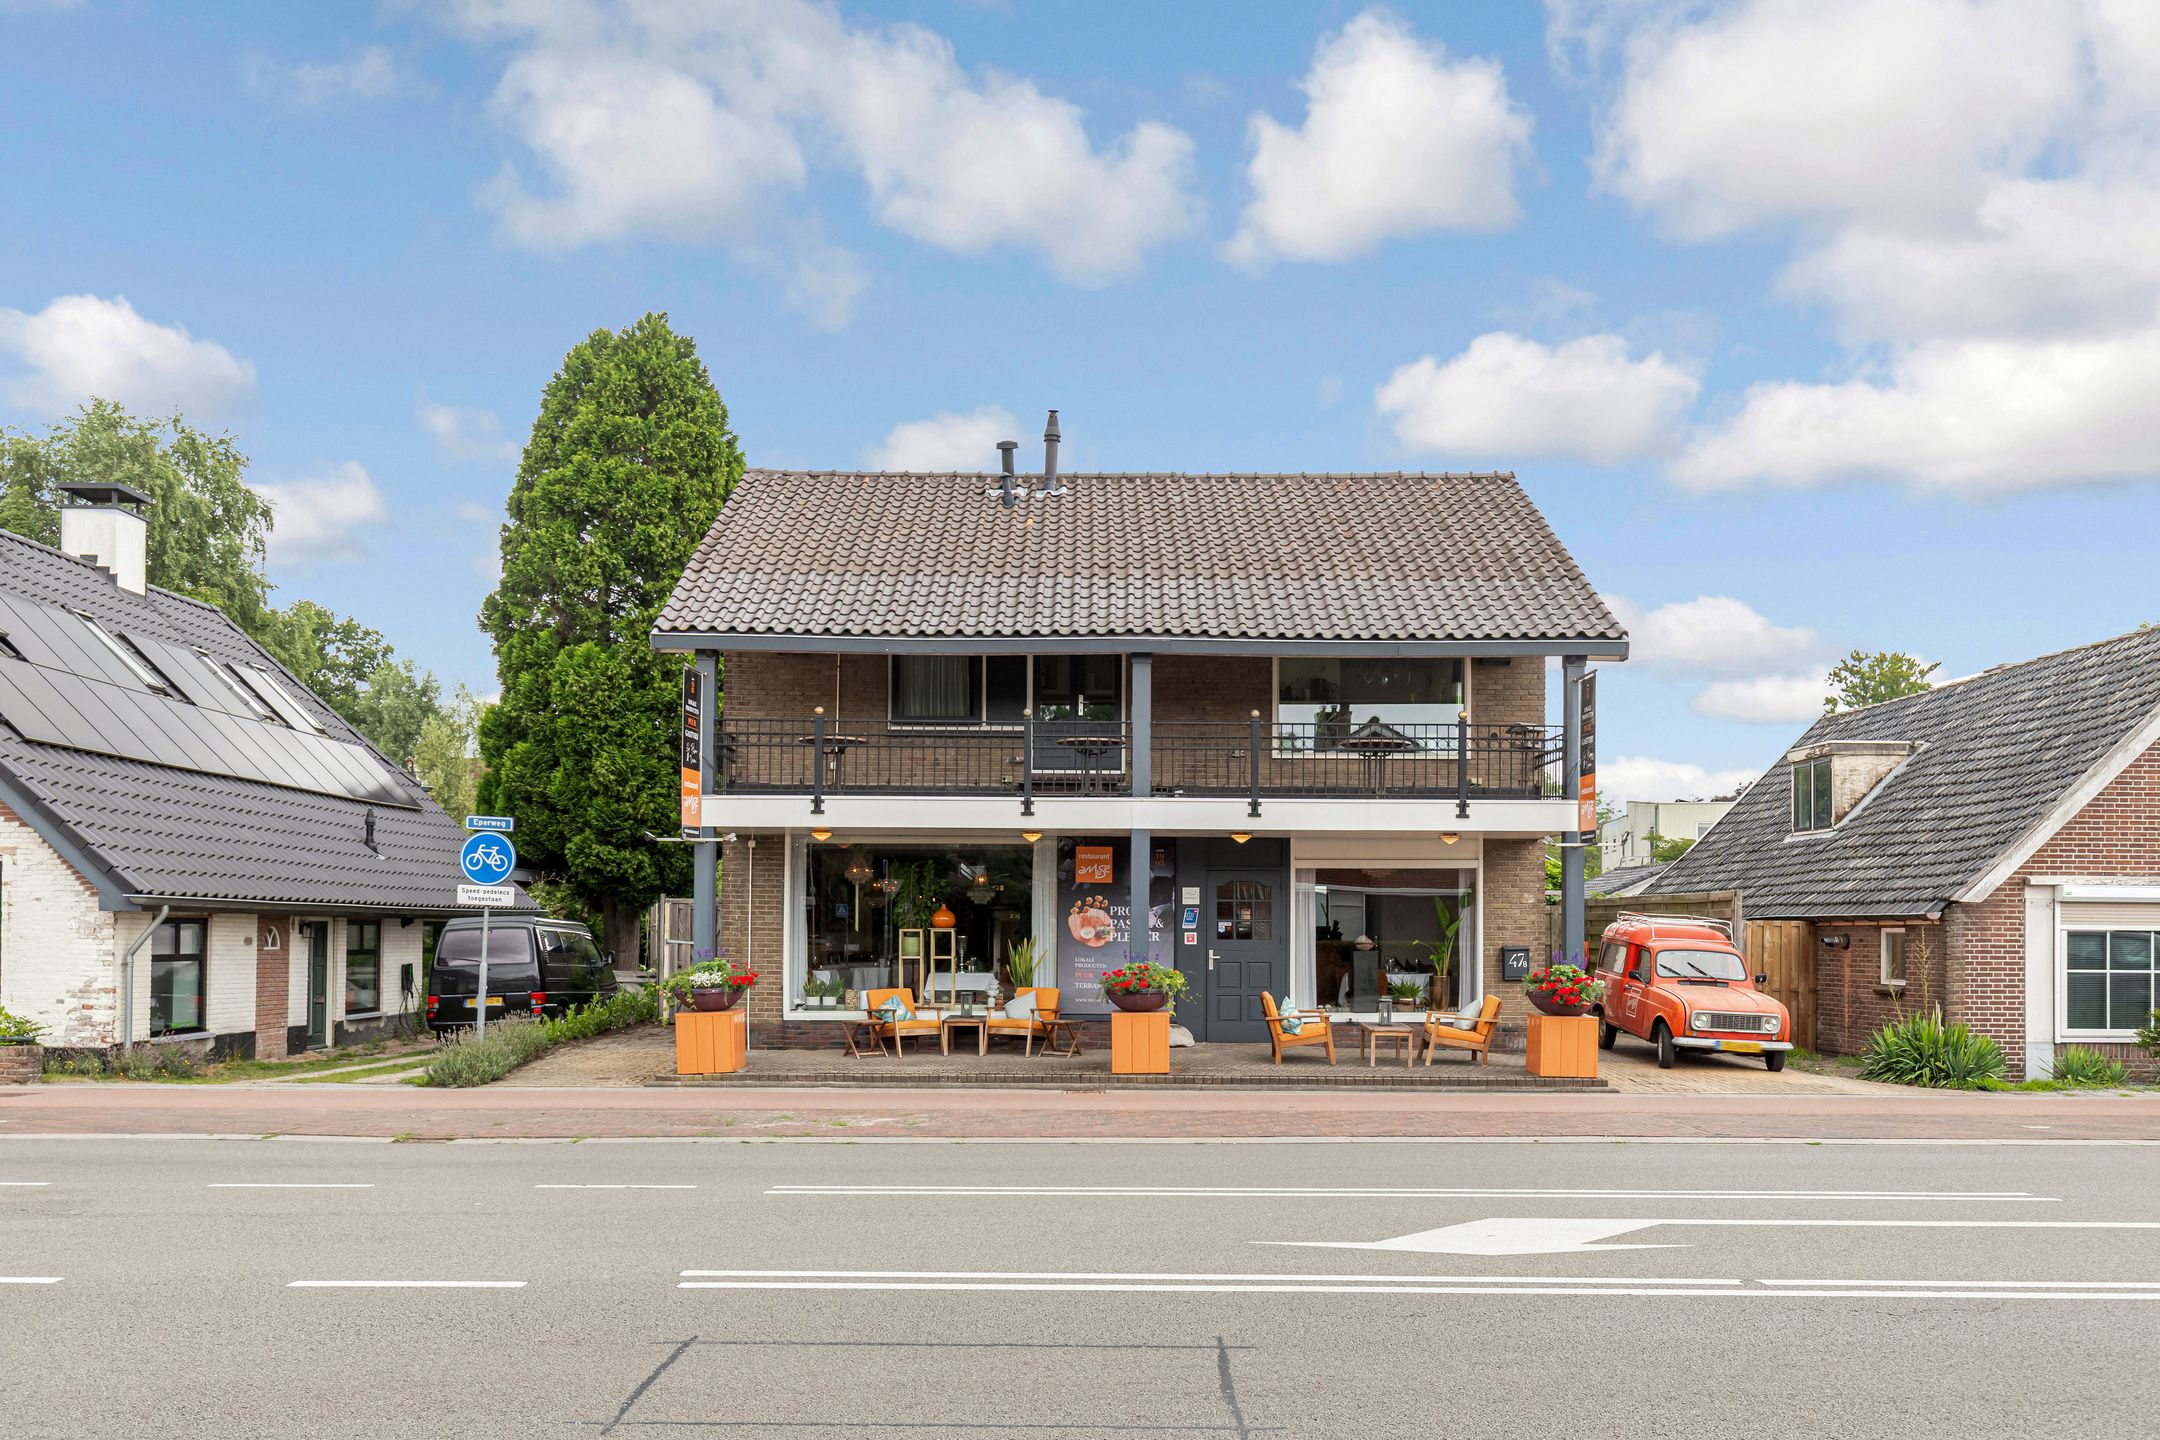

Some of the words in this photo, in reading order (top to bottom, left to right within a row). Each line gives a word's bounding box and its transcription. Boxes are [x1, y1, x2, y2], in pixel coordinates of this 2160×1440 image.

[473, 819, 506, 828] Eperweg
[461, 888, 510, 896] Speed-pedelecs
[468, 896, 502, 904] toegestaan
[1155, 918, 1164, 928] &
